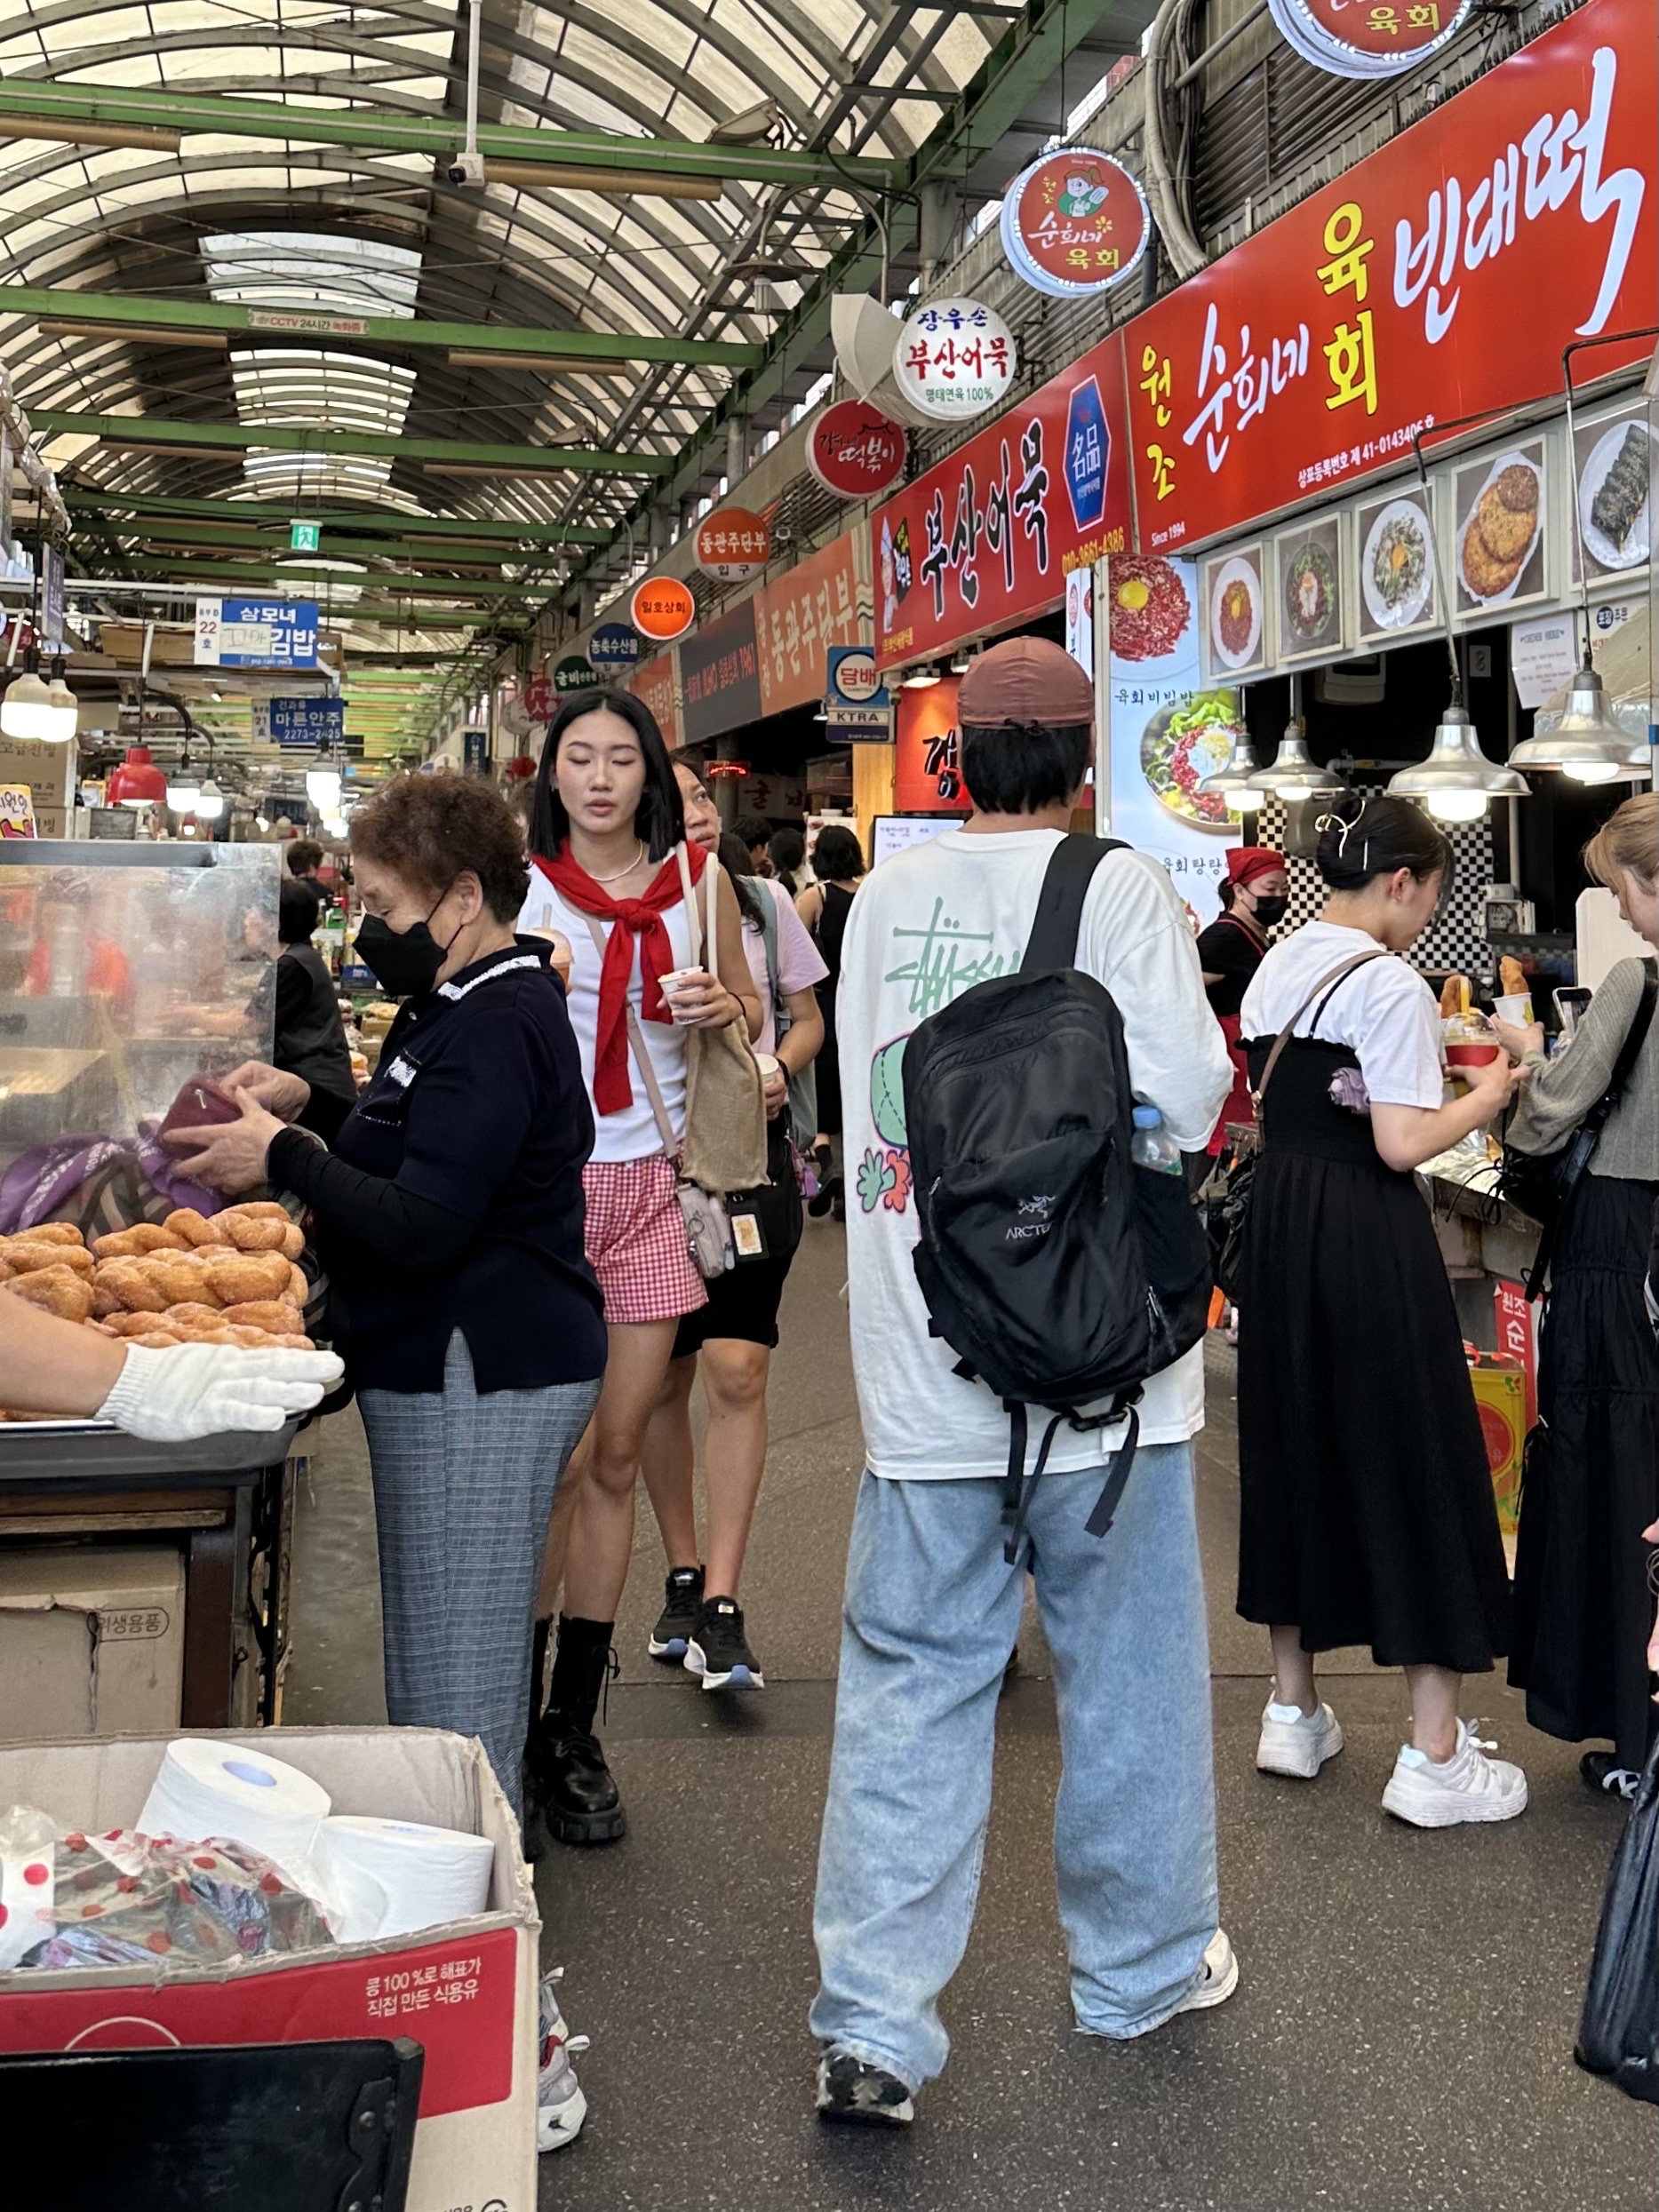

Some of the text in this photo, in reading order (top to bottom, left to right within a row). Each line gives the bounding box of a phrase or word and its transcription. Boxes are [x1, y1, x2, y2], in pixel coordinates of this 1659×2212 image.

[1366, 3, 1441, 35] 육회
[1392, 46, 1646, 344] 빈대떡
[1027, 211, 1103, 249] 순희네
[1065, 249, 1120, 270] 육회
[271, 316, 299, 327] CCTV
[299, 319, 331, 330] 24시간
[917, 306, 988, 331] 장우손
[1316, 202, 1378, 415] 육회
[905, 337, 1009, 380] 부산어묵
[926, 386, 993, 402] 명태연육 100%
[1183, 302, 1310, 473] 순희네
[1139, 344, 1176, 503] 원조
[838, 436, 895, 473] 떡볶이
[1072, 423, 1101, 481] 名品
[1298, 451, 1350, 489] 상표등록번호
[1350, 445, 1361, 465] 제
[921, 417, 1049, 622] 부산어묵
[1152, 521, 1185, 547] Since 1994
[240, 607, 297, 624] 삼모녀
[642, 601, 685, 614] 일호상회
[199, 621, 217, 633] 22
[270, 629, 316, 656] 김밥
[841, 667, 876, 686] 담배
[1114, 688, 1194, 707] 육회비빔밥
[275, 712, 341, 727] 마른안주
[836, 712, 879, 721] KTRA
[366, 1977, 381, 1997] 콩
[384, 1972, 410, 1992] 100
[441, 1956, 482, 1980] 해표가
[367, 1978, 479, 2017] 직접 만든 식용유
